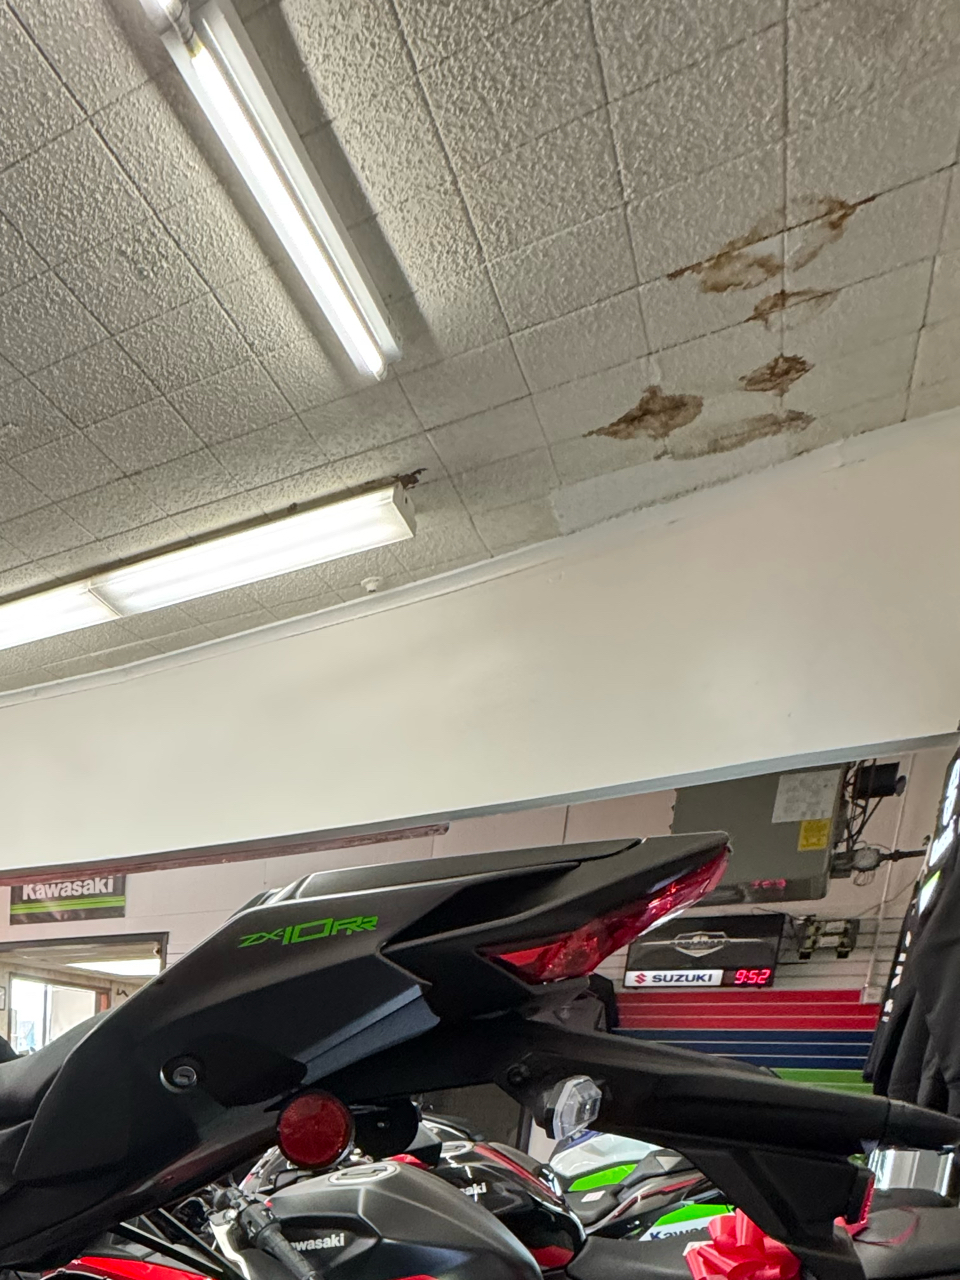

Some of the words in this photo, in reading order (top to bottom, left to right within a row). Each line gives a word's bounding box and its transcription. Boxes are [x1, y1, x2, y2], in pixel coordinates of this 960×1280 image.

[22, 876, 114, 901] Kawasaki
[652, 973, 713, 983] SUZUKI
[734, 968, 771, 984] 9:52
[290, 1232, 345, 1251] wasaki
